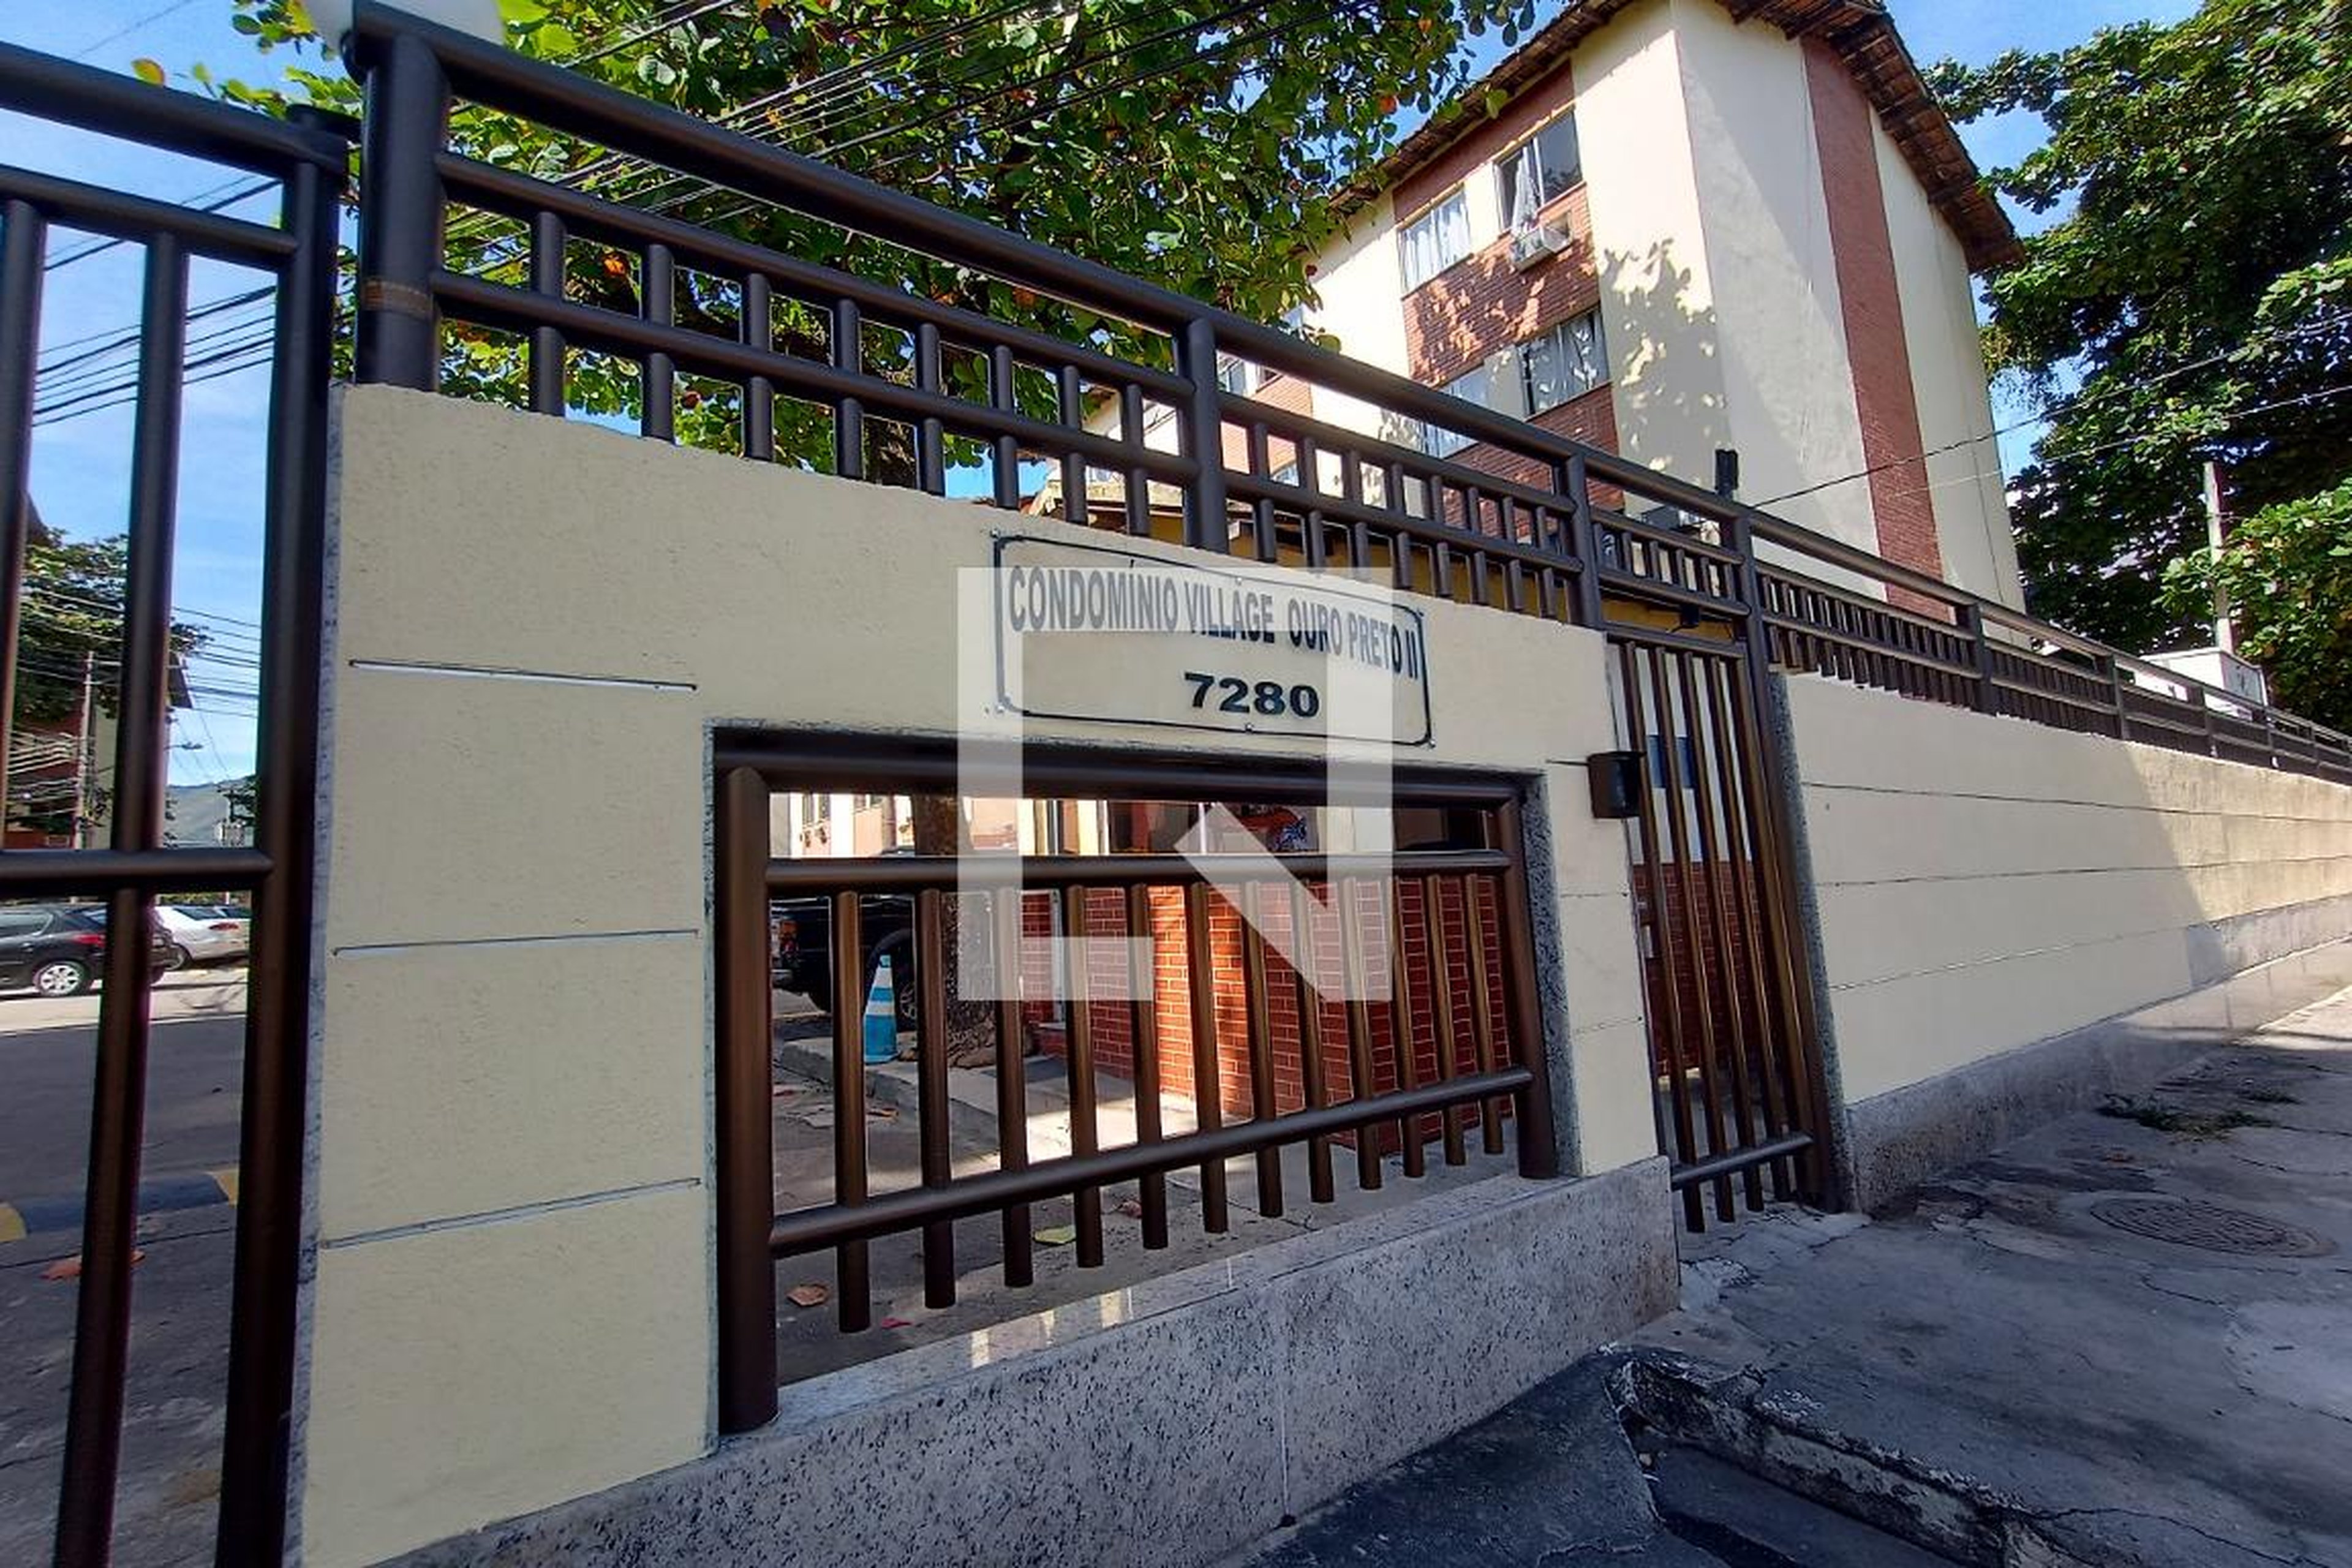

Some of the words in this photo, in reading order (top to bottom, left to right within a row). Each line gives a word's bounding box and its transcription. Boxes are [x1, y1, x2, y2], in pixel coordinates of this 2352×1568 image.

[1184, 581, 1275, 644] VILLAGE
[1288, 598, 1343, 656] OURO
[1349, 612, 1401, 673] PRETO
[1184, 672, 1319, 718] 7280
